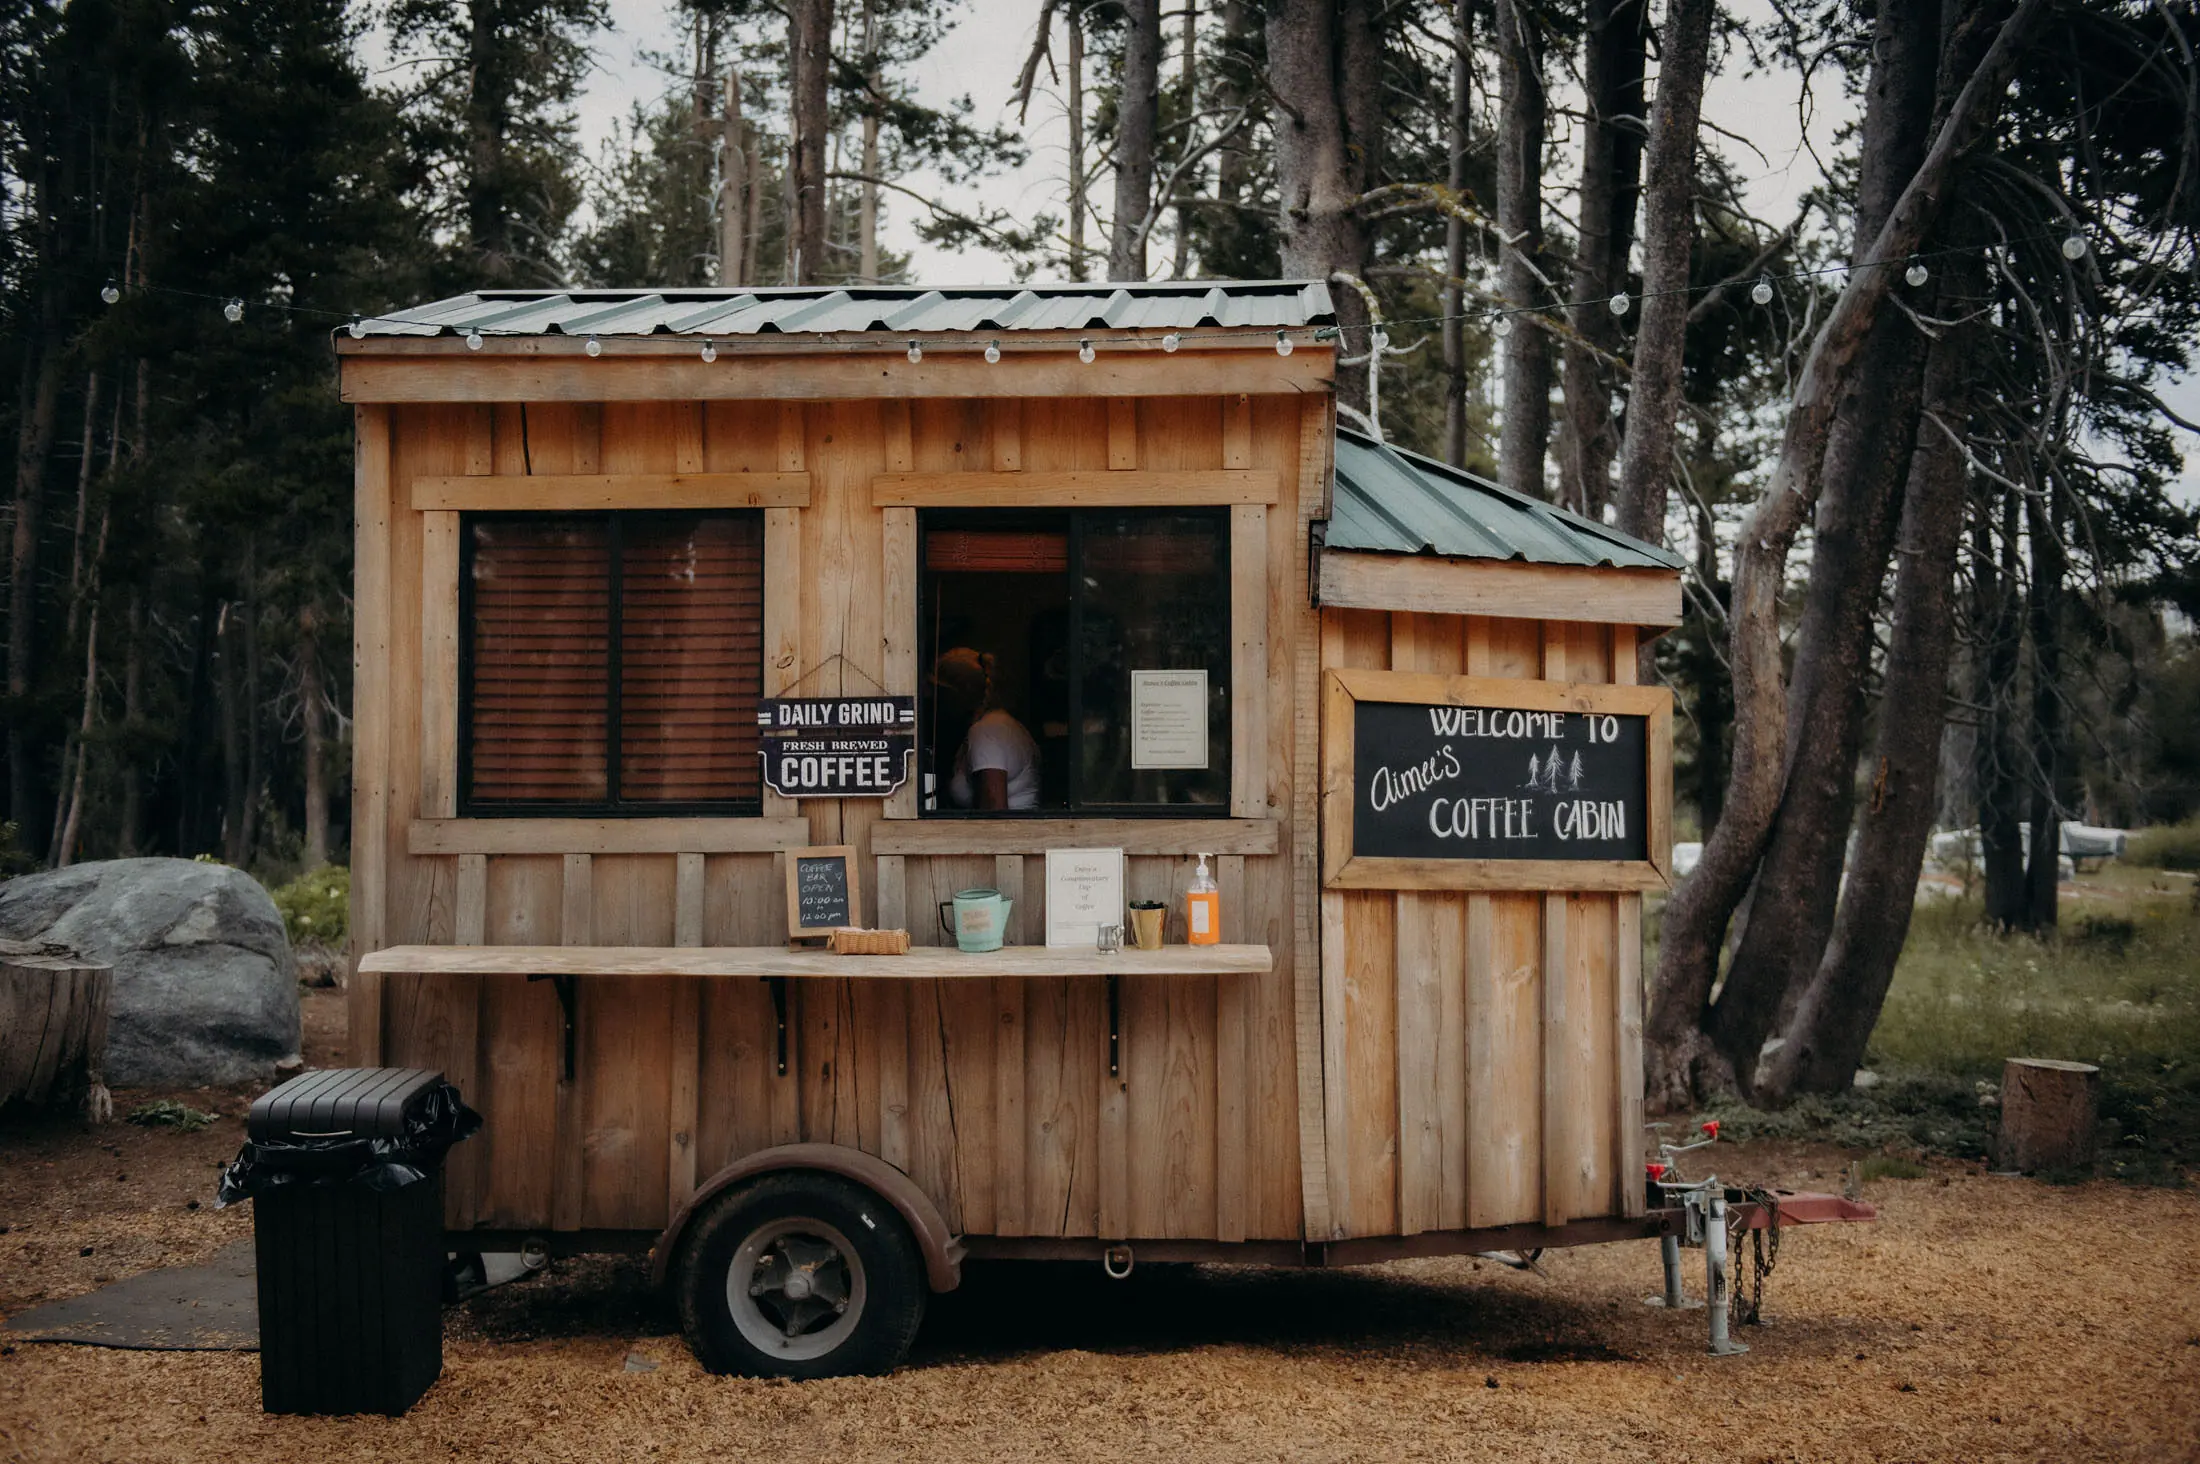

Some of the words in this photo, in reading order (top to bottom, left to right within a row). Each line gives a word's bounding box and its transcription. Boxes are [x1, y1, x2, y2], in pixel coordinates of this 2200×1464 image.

[779, 703, 833, 725] DAILY
[838, 702, 895, 725] GRIND
[1429, 707, 1565, 739] WELCOME
[1582, 713, 1619, 743] TO
[782, 741, 825, 751] FRESH
[831, 740, 888, 750] BREWED
[781, 756, 891, 788] COFFEE
[1429, 797, 1538, 839] COFFEE
[1554, 800, 1625, 840] CABIN
[800, 863, 833, 872] COFFEE
[806, 873, 828, 883] BAR
[802, 884, 833, 893] OPEN
